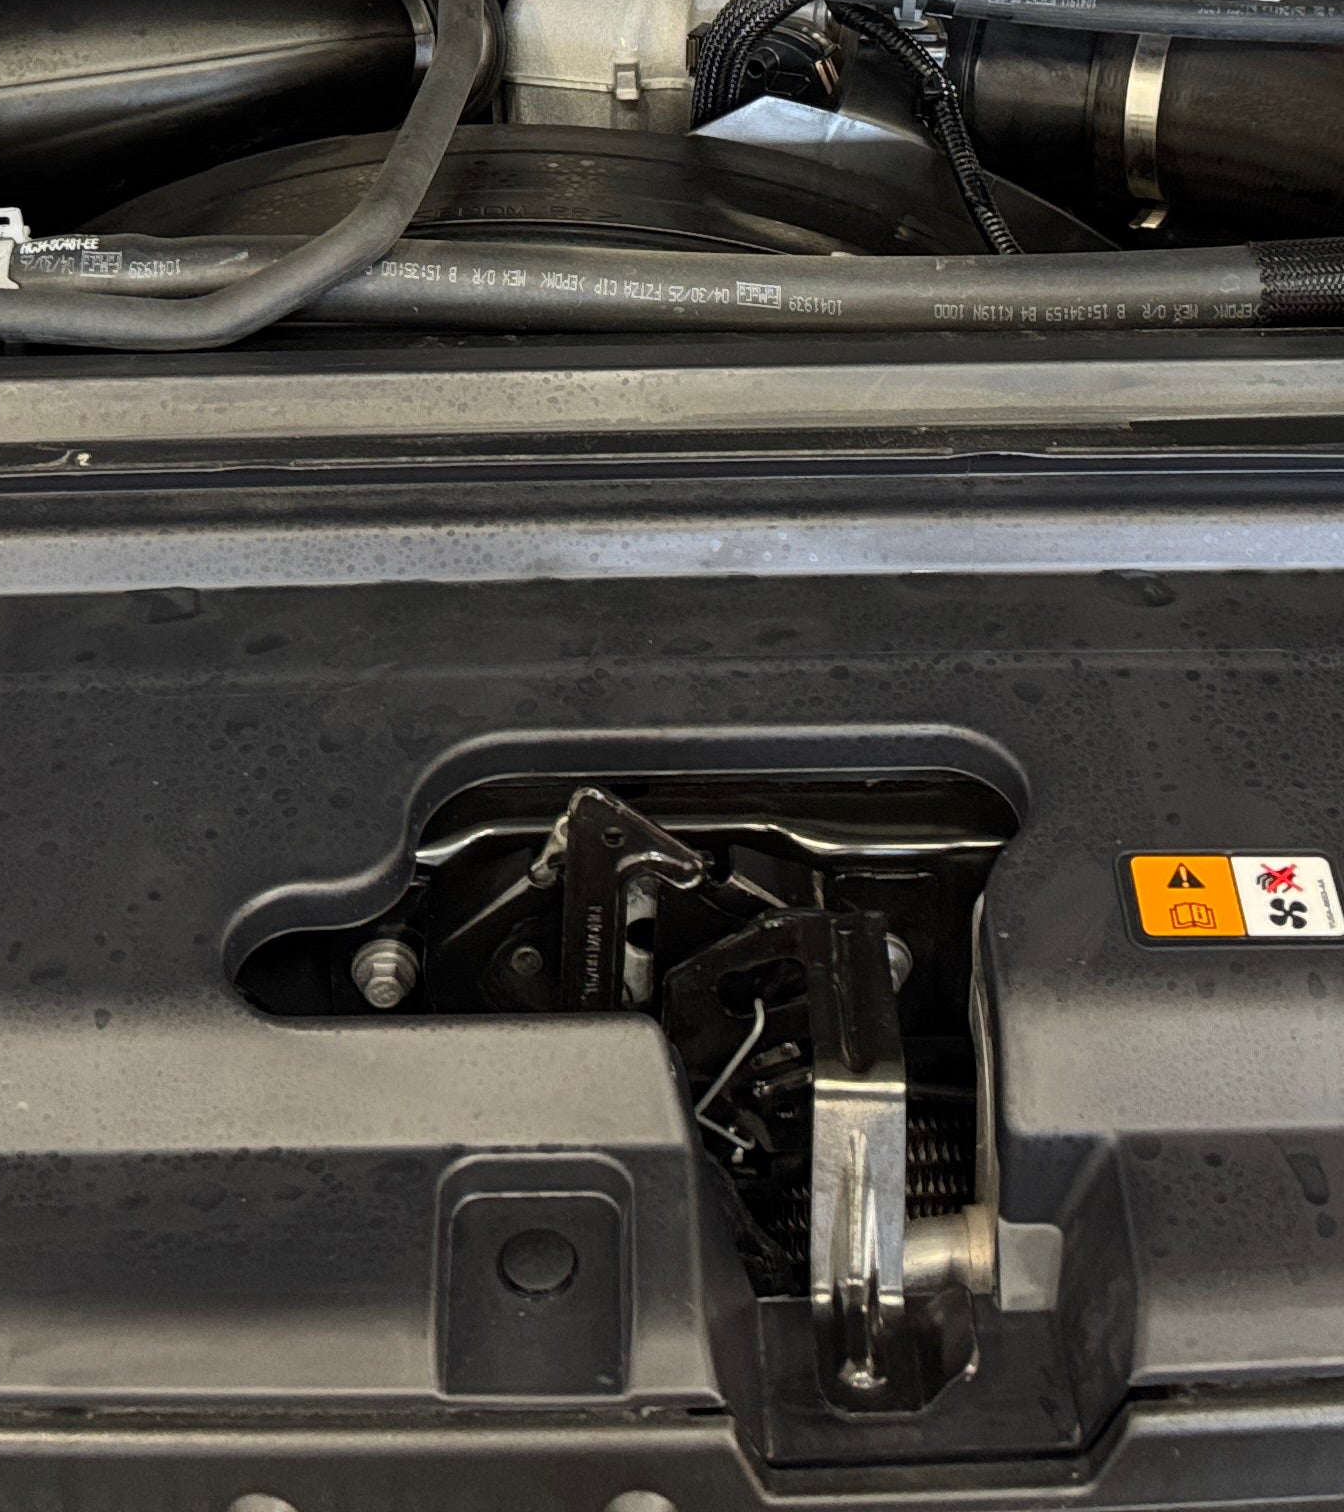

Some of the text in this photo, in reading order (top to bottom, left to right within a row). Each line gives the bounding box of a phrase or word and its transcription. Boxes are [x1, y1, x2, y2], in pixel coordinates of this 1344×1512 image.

[128, 258, 182, 279] 1041939
[381, 261, 442, 282] 15:35:00
[502, 268, 527, 287] MEX
[594, 277, 618, 298] CIP
[668, 284, 730, 304] 04/30/25
[788, 295, 843, 315] 1041939
[1045, 303, 1109, 321] 15:34:59
